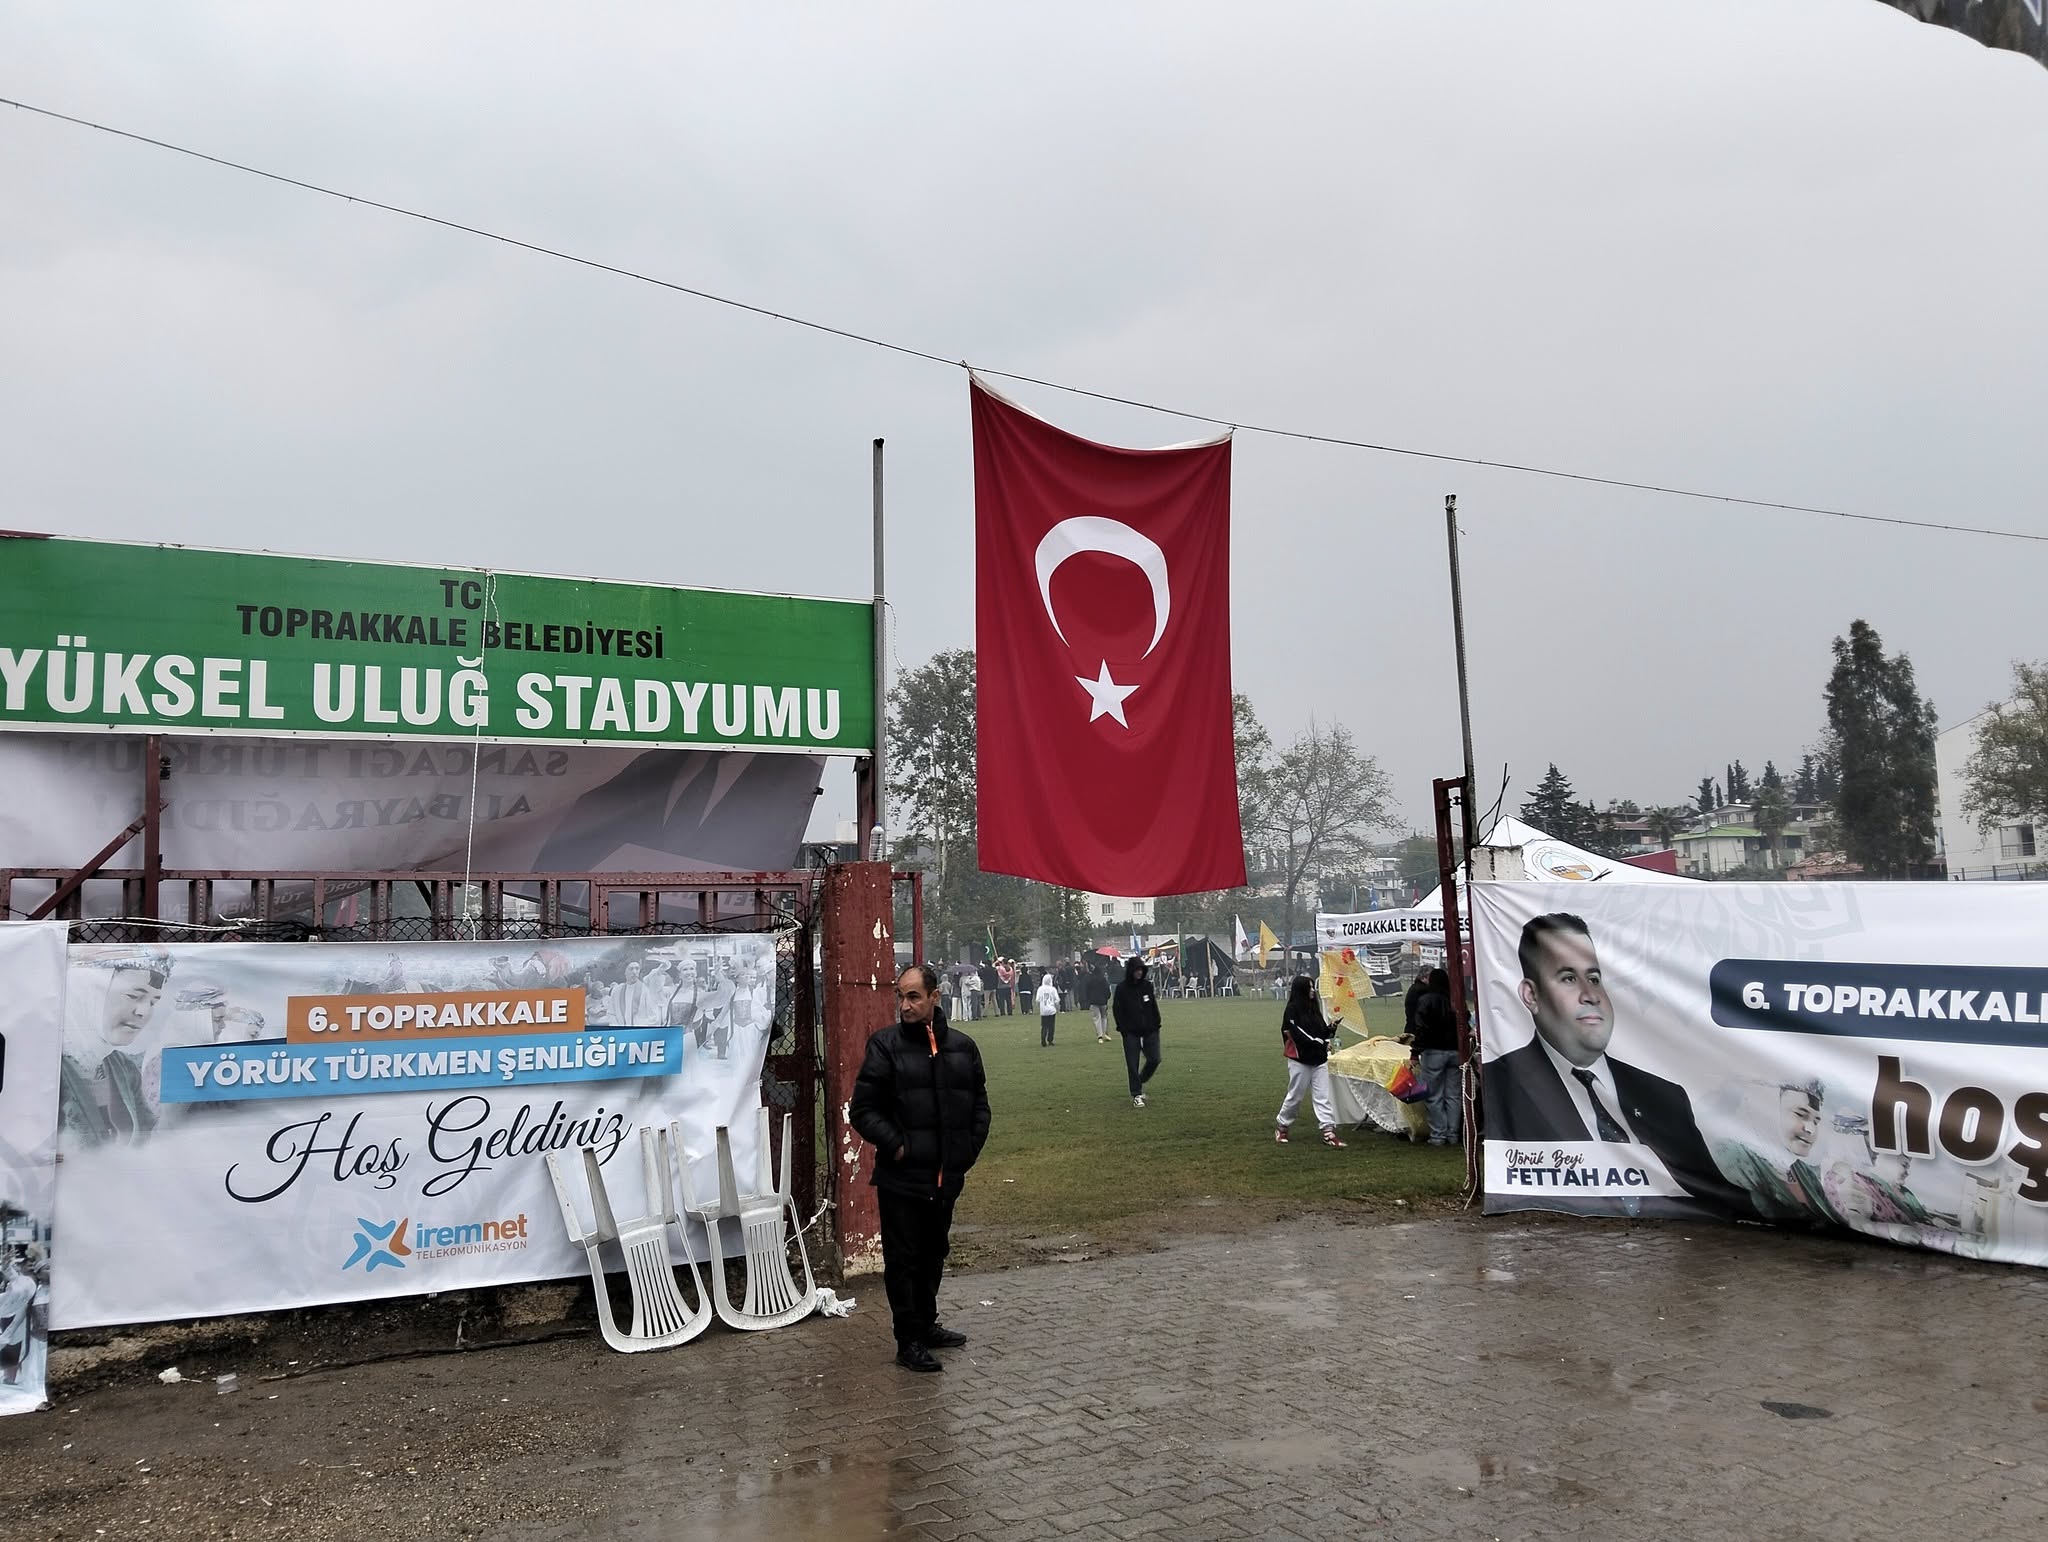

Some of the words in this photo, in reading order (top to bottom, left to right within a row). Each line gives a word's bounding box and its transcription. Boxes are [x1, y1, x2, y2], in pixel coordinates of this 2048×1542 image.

[440, 579, 481, 609] TC
[237, 605, 467, 647] TOPRAKKALE
[480, 618, 664, 660] BELEDİYESİ
[0, 635, 284, 720] YÜKSEL
[313, 655, 489, 727] ULUĞ
[515, 673, 841, 741] STADYUMU
[1342, 918, 1407, 936] TOPRAKKALE
[1742, 981, 1770, 1010] 6.
[308, 1007, 339, 1031] 6.
[349, 999, 568, 1031] TOPRAKKALE
[187, 1051, 317, 1087] YÖRÜK
[325, 1048, 491, 1081] TÜRKMEN
[226, 1112, 409, 1203] Hoş
[422, 1095, 632, 1197] Geldiniz
[1505, 1148, 1544, 1168] Yörük
[1551, 1149, 1584, 1169] Beyi
[1506, 1167, 1600, 1187] FETTAH
[1605, 1167, 1650, 1187] ACI
[416, 1214, 528, 1249] iremnet
[416, 1239, 528, 1261] TELEKOMÜNİKASYON
